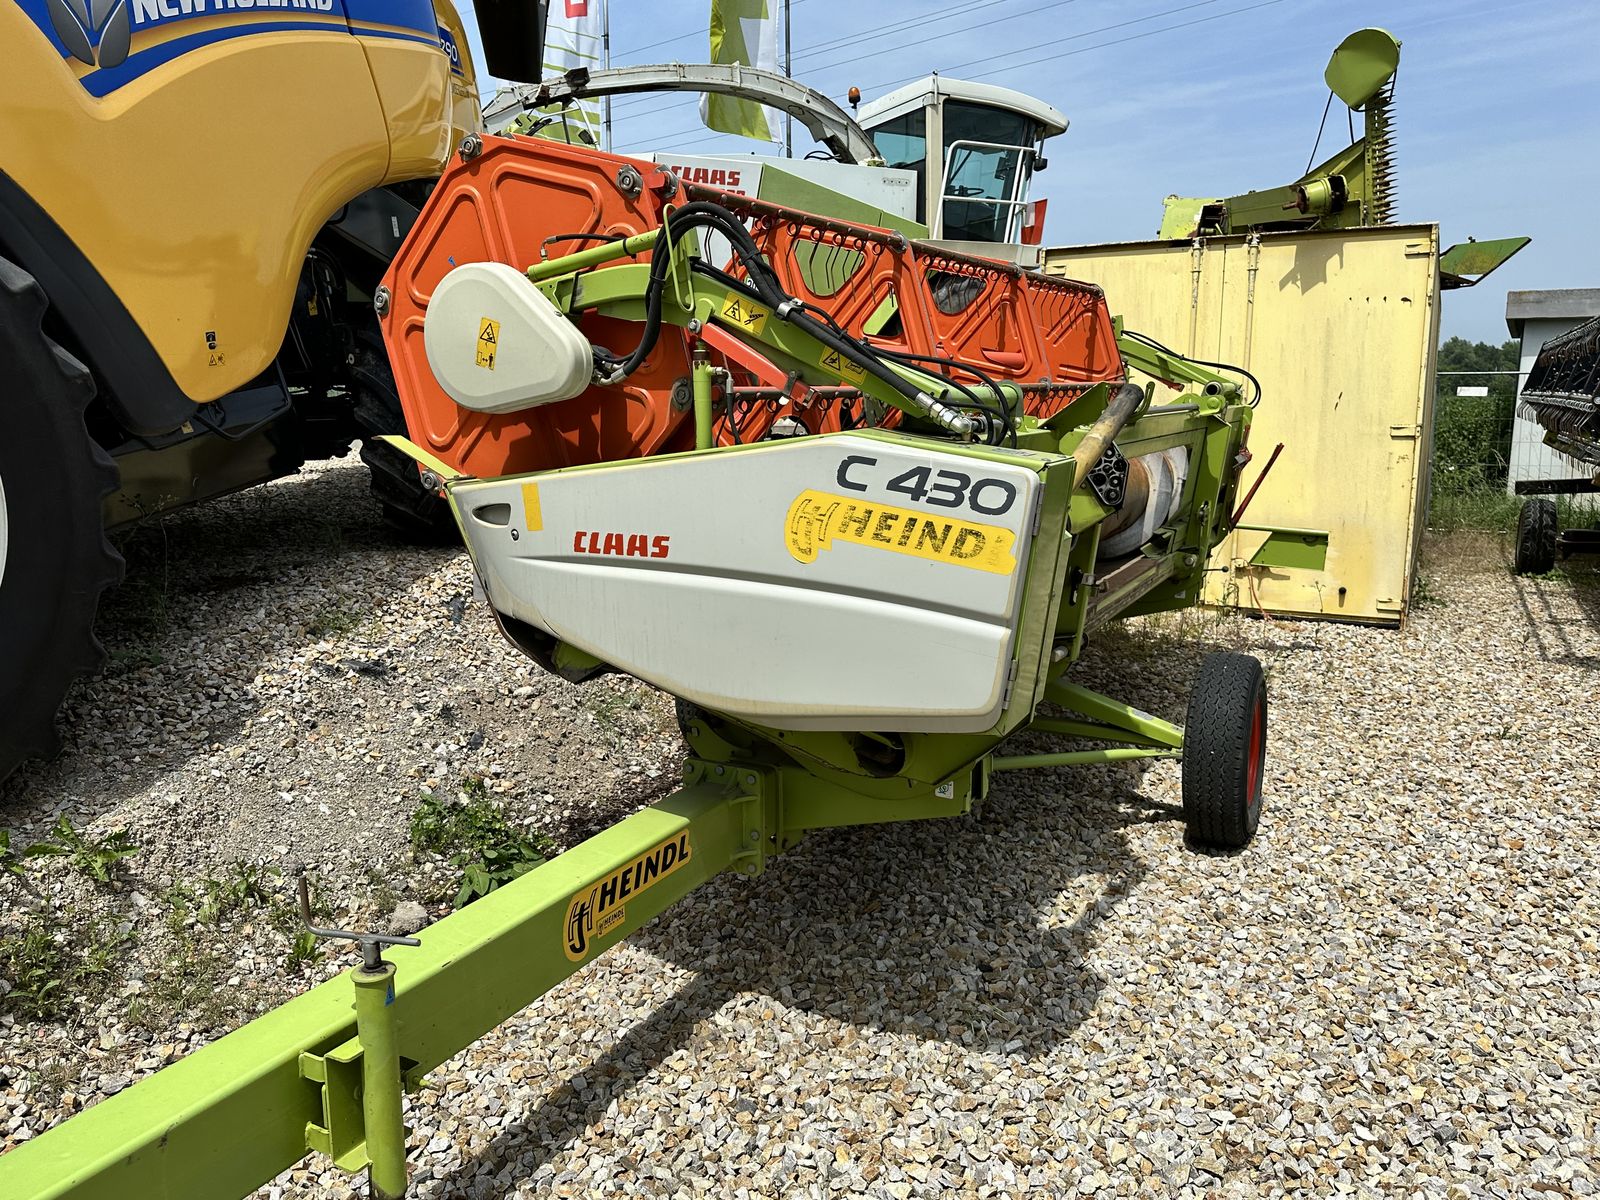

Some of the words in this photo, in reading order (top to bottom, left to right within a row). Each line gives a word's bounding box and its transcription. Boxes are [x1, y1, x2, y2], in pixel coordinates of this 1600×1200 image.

[836, 455, 878, 492] C
[886, 466, 1017, 515] 430
[573, 531, 670, 558] CLAAS
[838, 505, 1005, 566] HEIND
[598, 834, 689, 913] HEINDL
